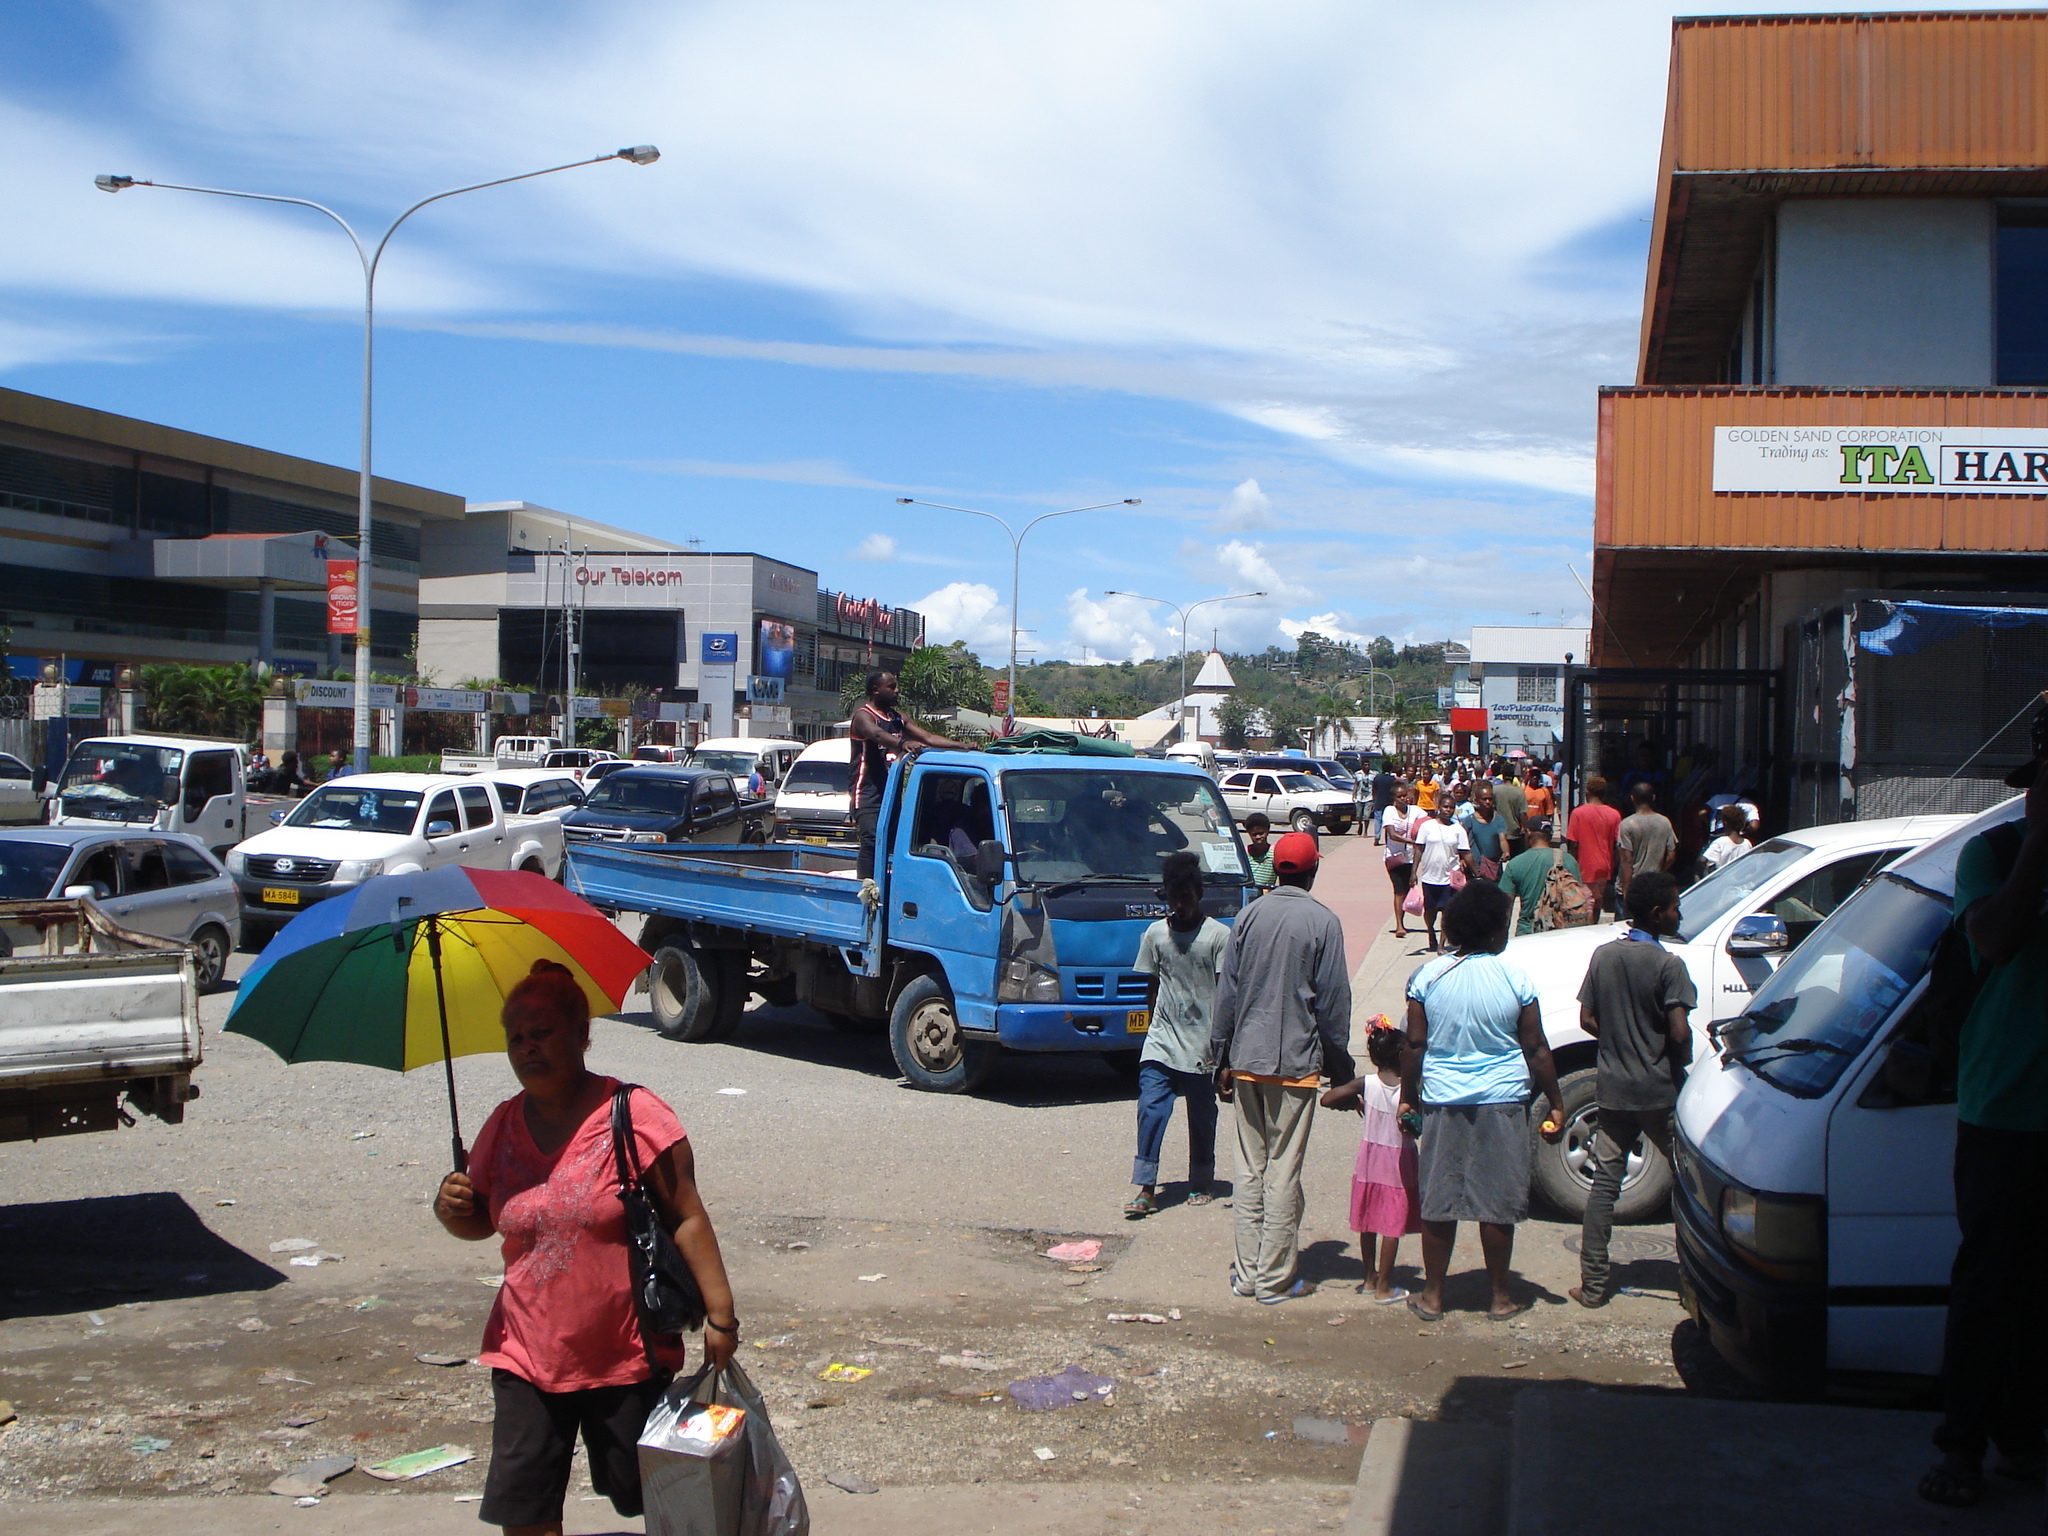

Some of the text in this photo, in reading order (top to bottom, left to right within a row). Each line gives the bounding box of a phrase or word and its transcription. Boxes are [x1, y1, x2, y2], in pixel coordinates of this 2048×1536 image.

[1728, 430, 1943, 443] GOLDEN SAND CORPORATION
[1758, 445, 1829, 462] Trading as:
[1840, 445, 1935, 484] ITA
[576, 566, 683, 586] Our Telekom
[311, 686, 348, 698] DISCOUNT
